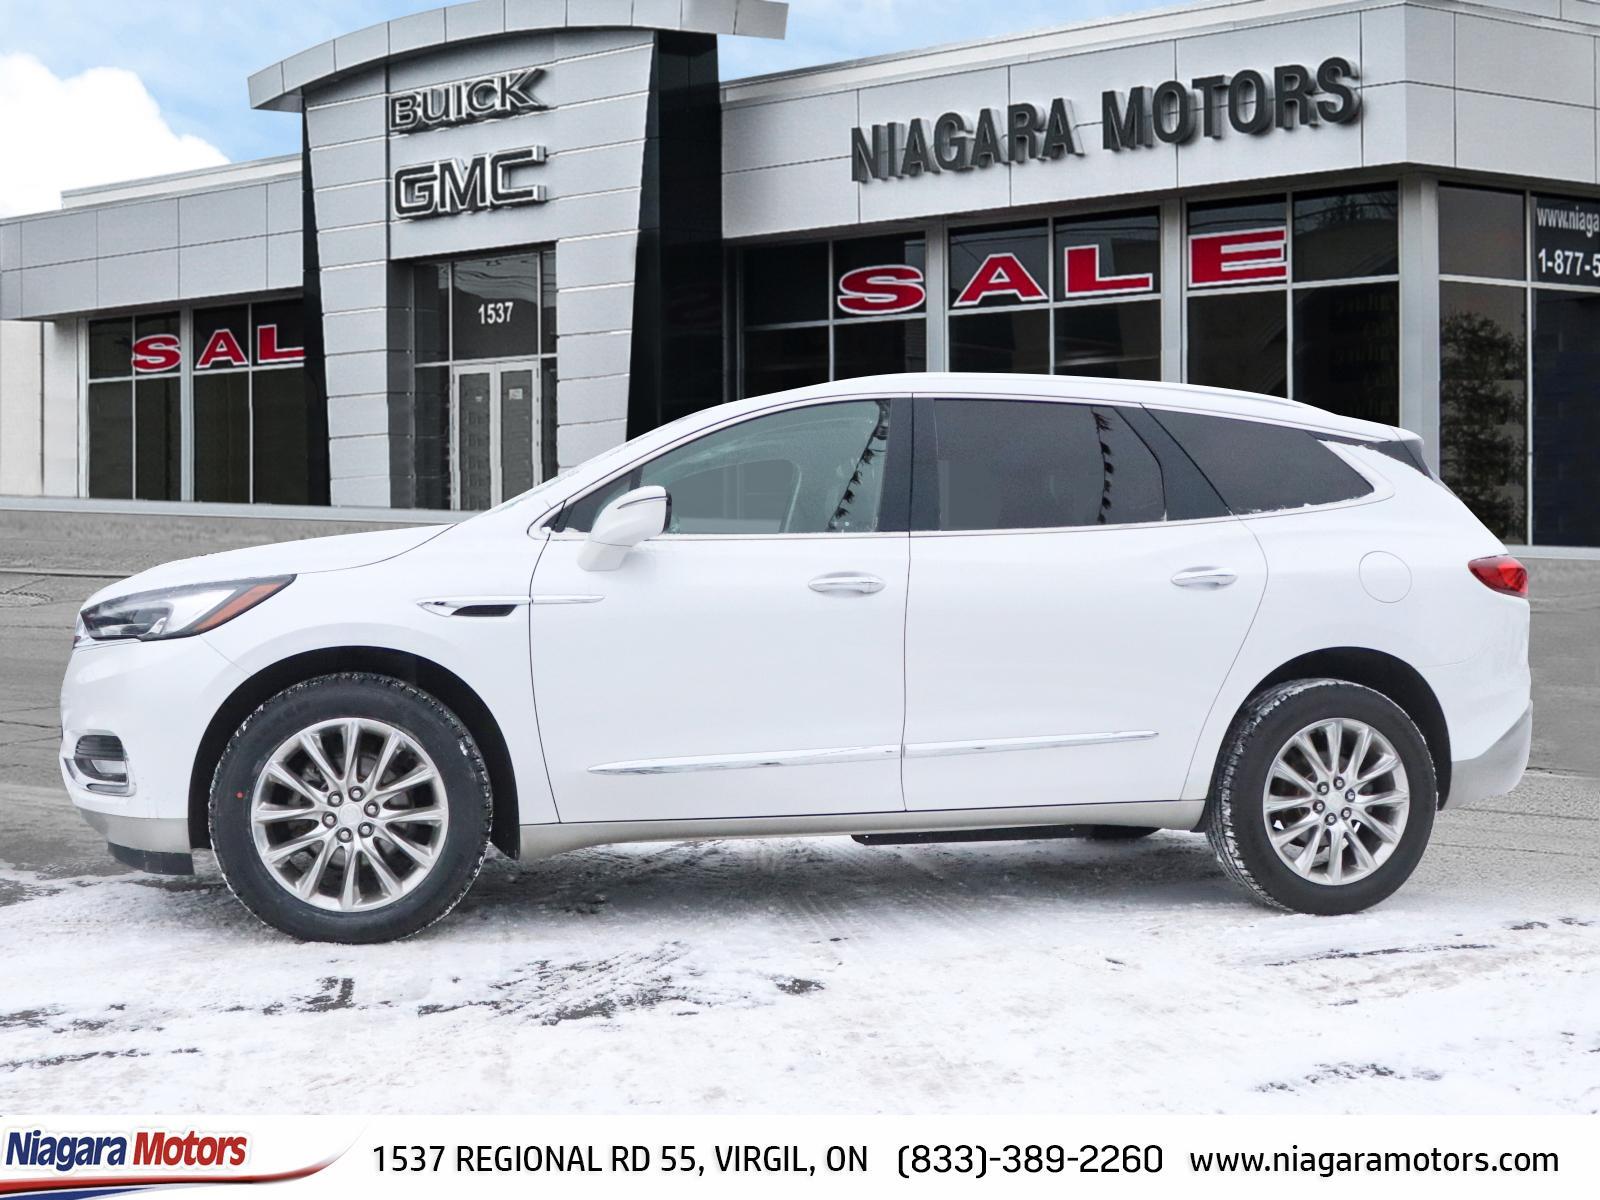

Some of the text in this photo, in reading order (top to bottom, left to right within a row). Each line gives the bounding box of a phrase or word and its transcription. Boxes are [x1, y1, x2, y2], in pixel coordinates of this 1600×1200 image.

[390, 68, 547, 131] BUICK
[851, 57, 1362, 183] NIAGARA MOTORS
[394, 145, 547, 219] GMC
[837, 227, 1288, 315] SALE
[478, 301, 514, 325] 1537
